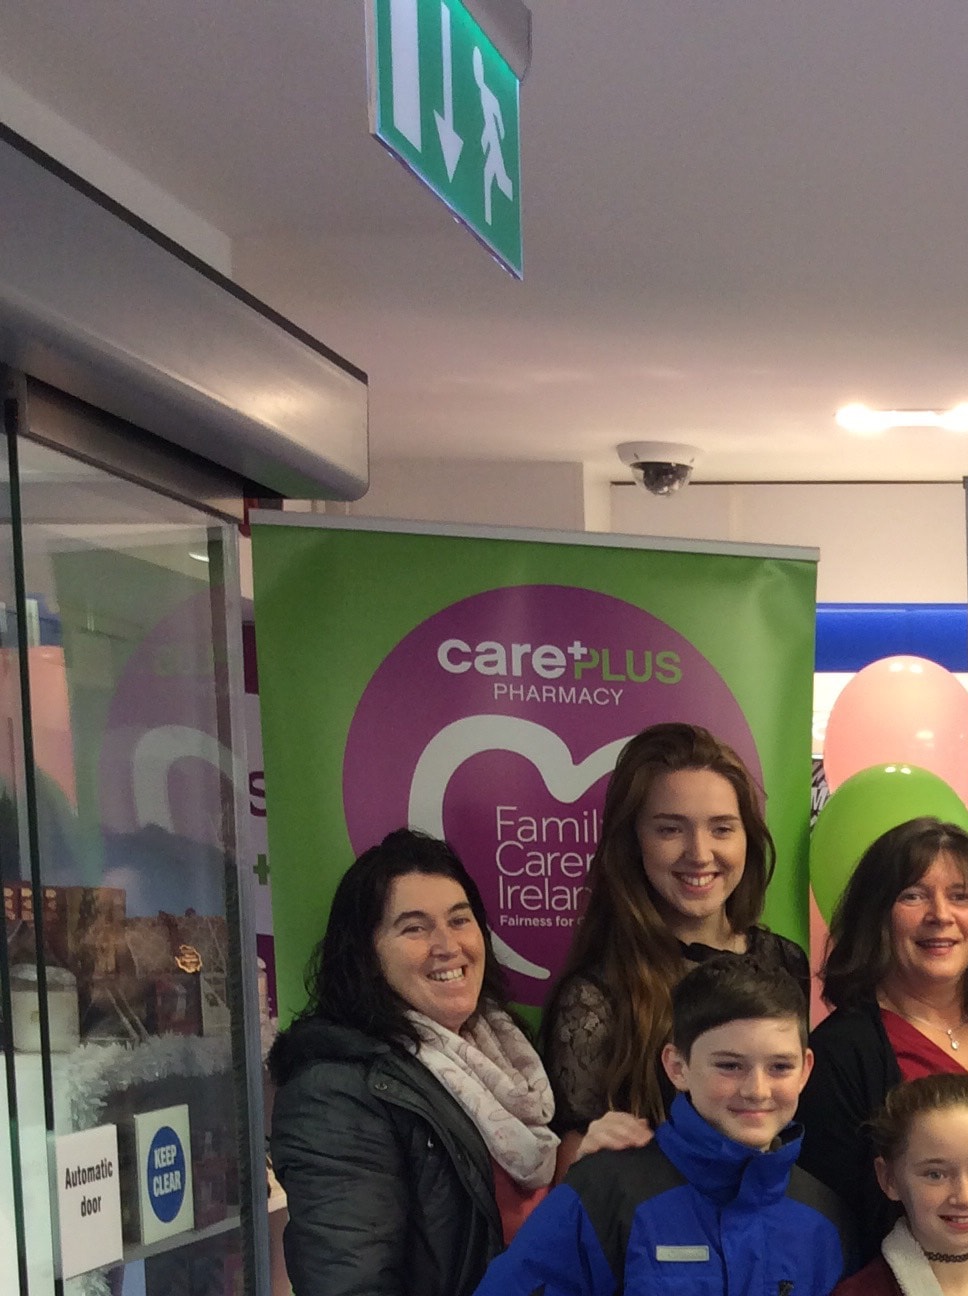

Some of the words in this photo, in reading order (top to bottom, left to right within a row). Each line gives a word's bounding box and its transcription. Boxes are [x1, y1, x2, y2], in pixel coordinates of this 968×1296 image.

[493, 682, 624, 706] PHARMACY
[496, 805, 603, 844] Famil
[495, 841, 595, 878] Carer
[498, 875, 593, 911] Irelan
[500, 914, 553, 927] Fairness
[556, 915, 575, 927] for
[154, 1144, 177, 1170] KEEP
[65, 1157, 113, 1190] Automatic
[153, 1170, 181, 1198] CLEAR
[80, 1195, 103, 1218] door
